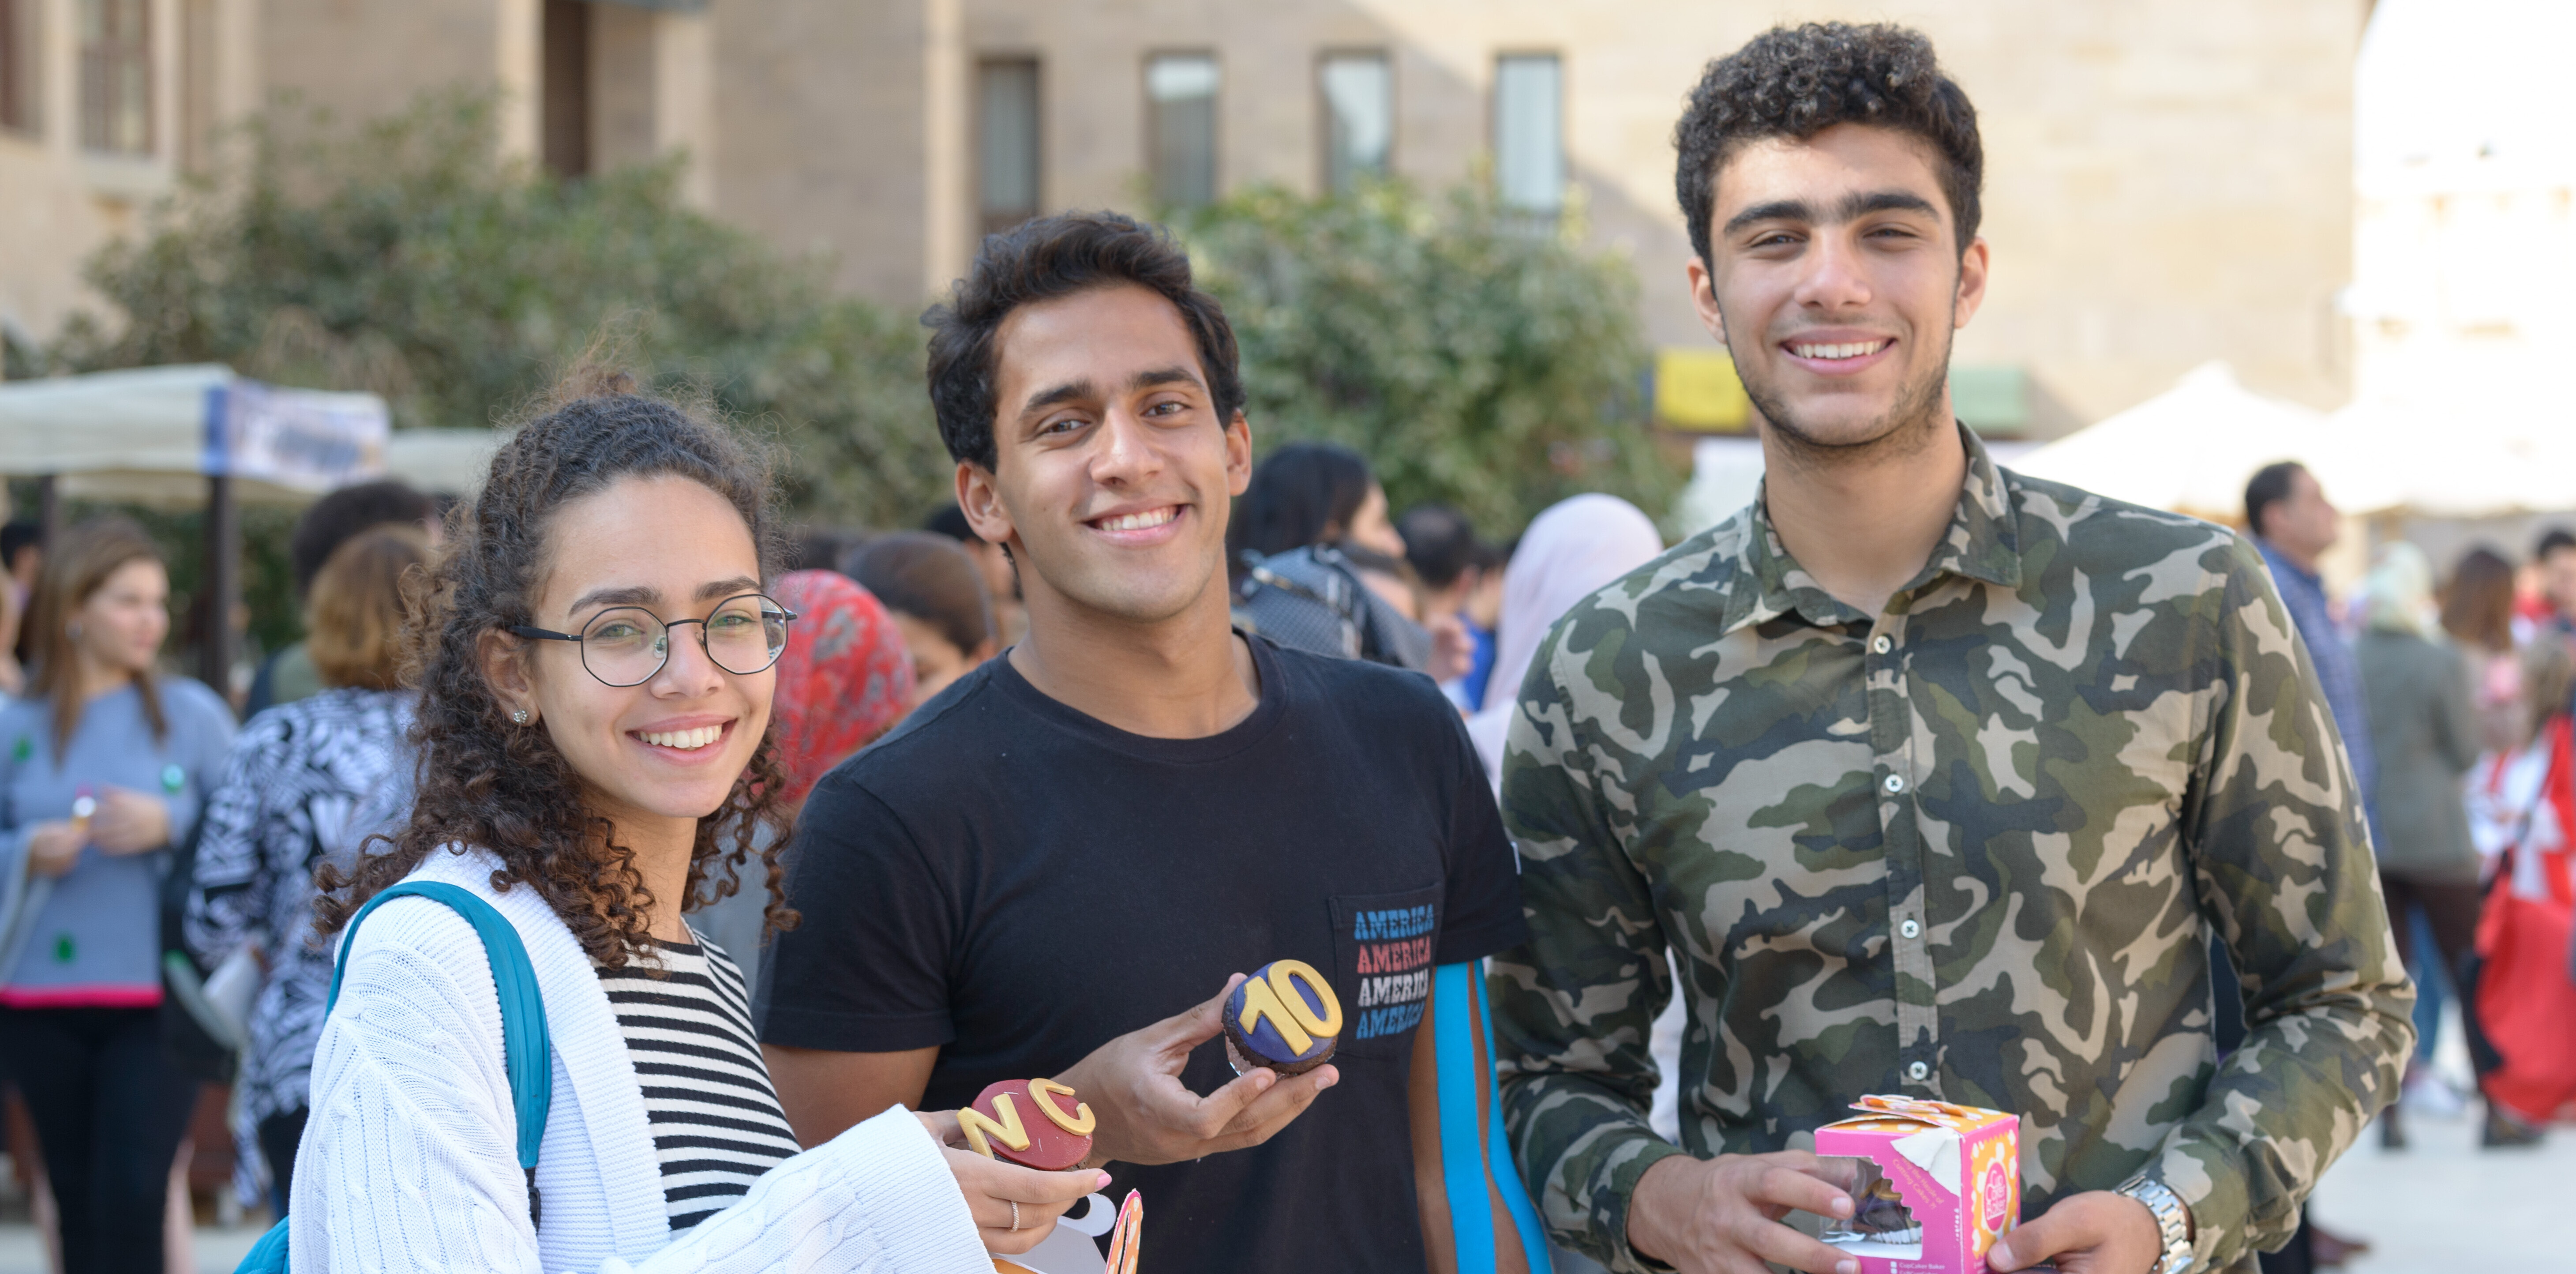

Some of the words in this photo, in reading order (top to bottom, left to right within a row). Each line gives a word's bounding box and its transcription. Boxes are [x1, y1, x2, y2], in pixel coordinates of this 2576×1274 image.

[1354, 903, 1433, 940] AMERICA
[1357, 936, 1430, 973] AMERICA
[1238, 959, 1342, 1056] 10
